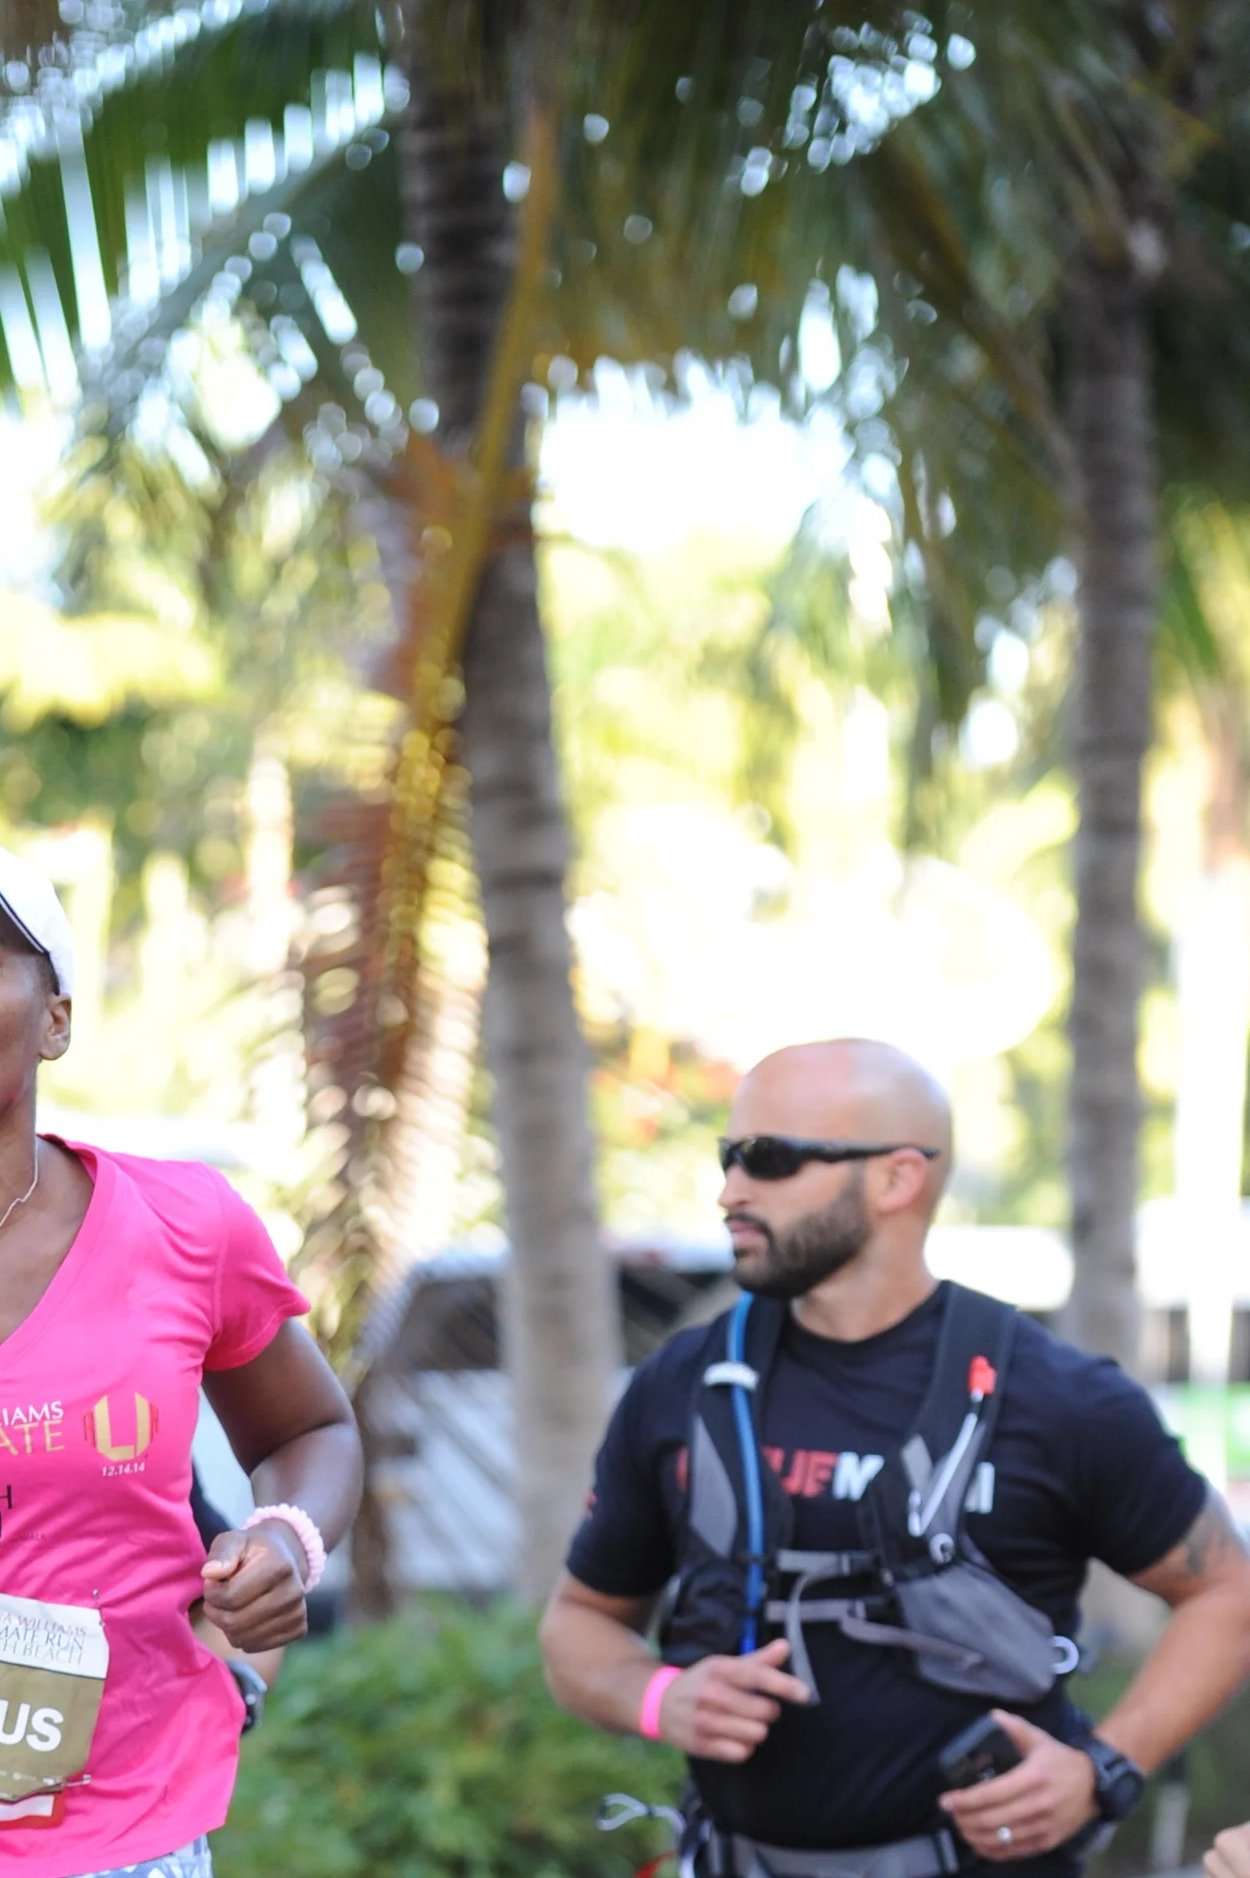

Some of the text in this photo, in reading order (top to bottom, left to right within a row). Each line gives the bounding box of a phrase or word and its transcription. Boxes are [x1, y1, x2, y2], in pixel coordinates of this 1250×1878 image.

[102, 1461, 146, 1477] 12.14.14
[18, 1615, 87, 1638] WILLIAMS
[45, 1631, 85, 1651] RUN
[22, 1643, 83, 1666] BEACH
